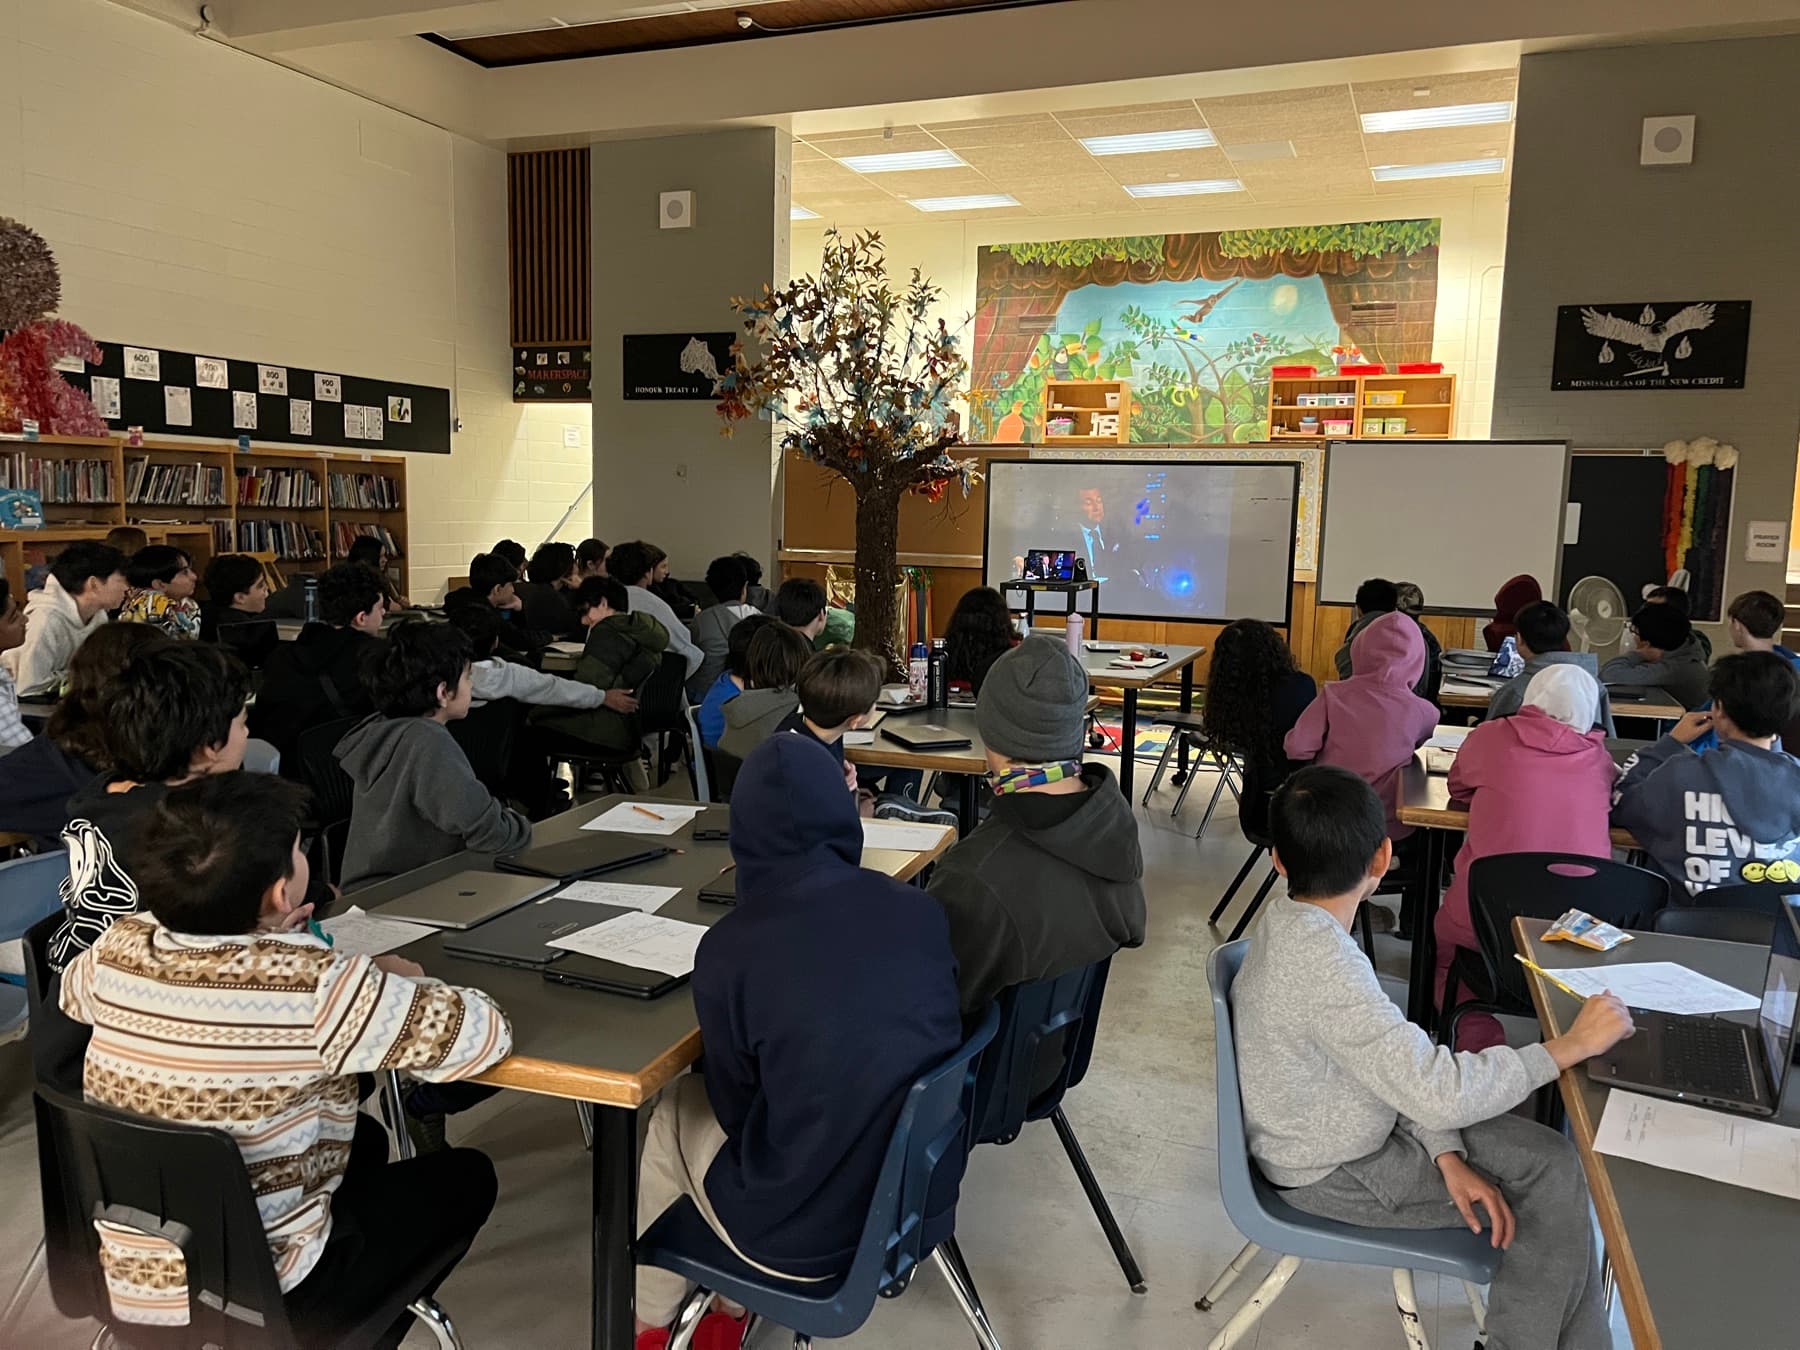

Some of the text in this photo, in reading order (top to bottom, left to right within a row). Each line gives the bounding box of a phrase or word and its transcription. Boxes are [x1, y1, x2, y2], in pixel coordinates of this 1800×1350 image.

[133, 353, 149, 363] 600
[266, 370, 279, 379] 800
[322, 379, 334, 387] 900
[1691, 377, 1724, 385] CREDIT
[1684, 857, 1731, 883] OF
